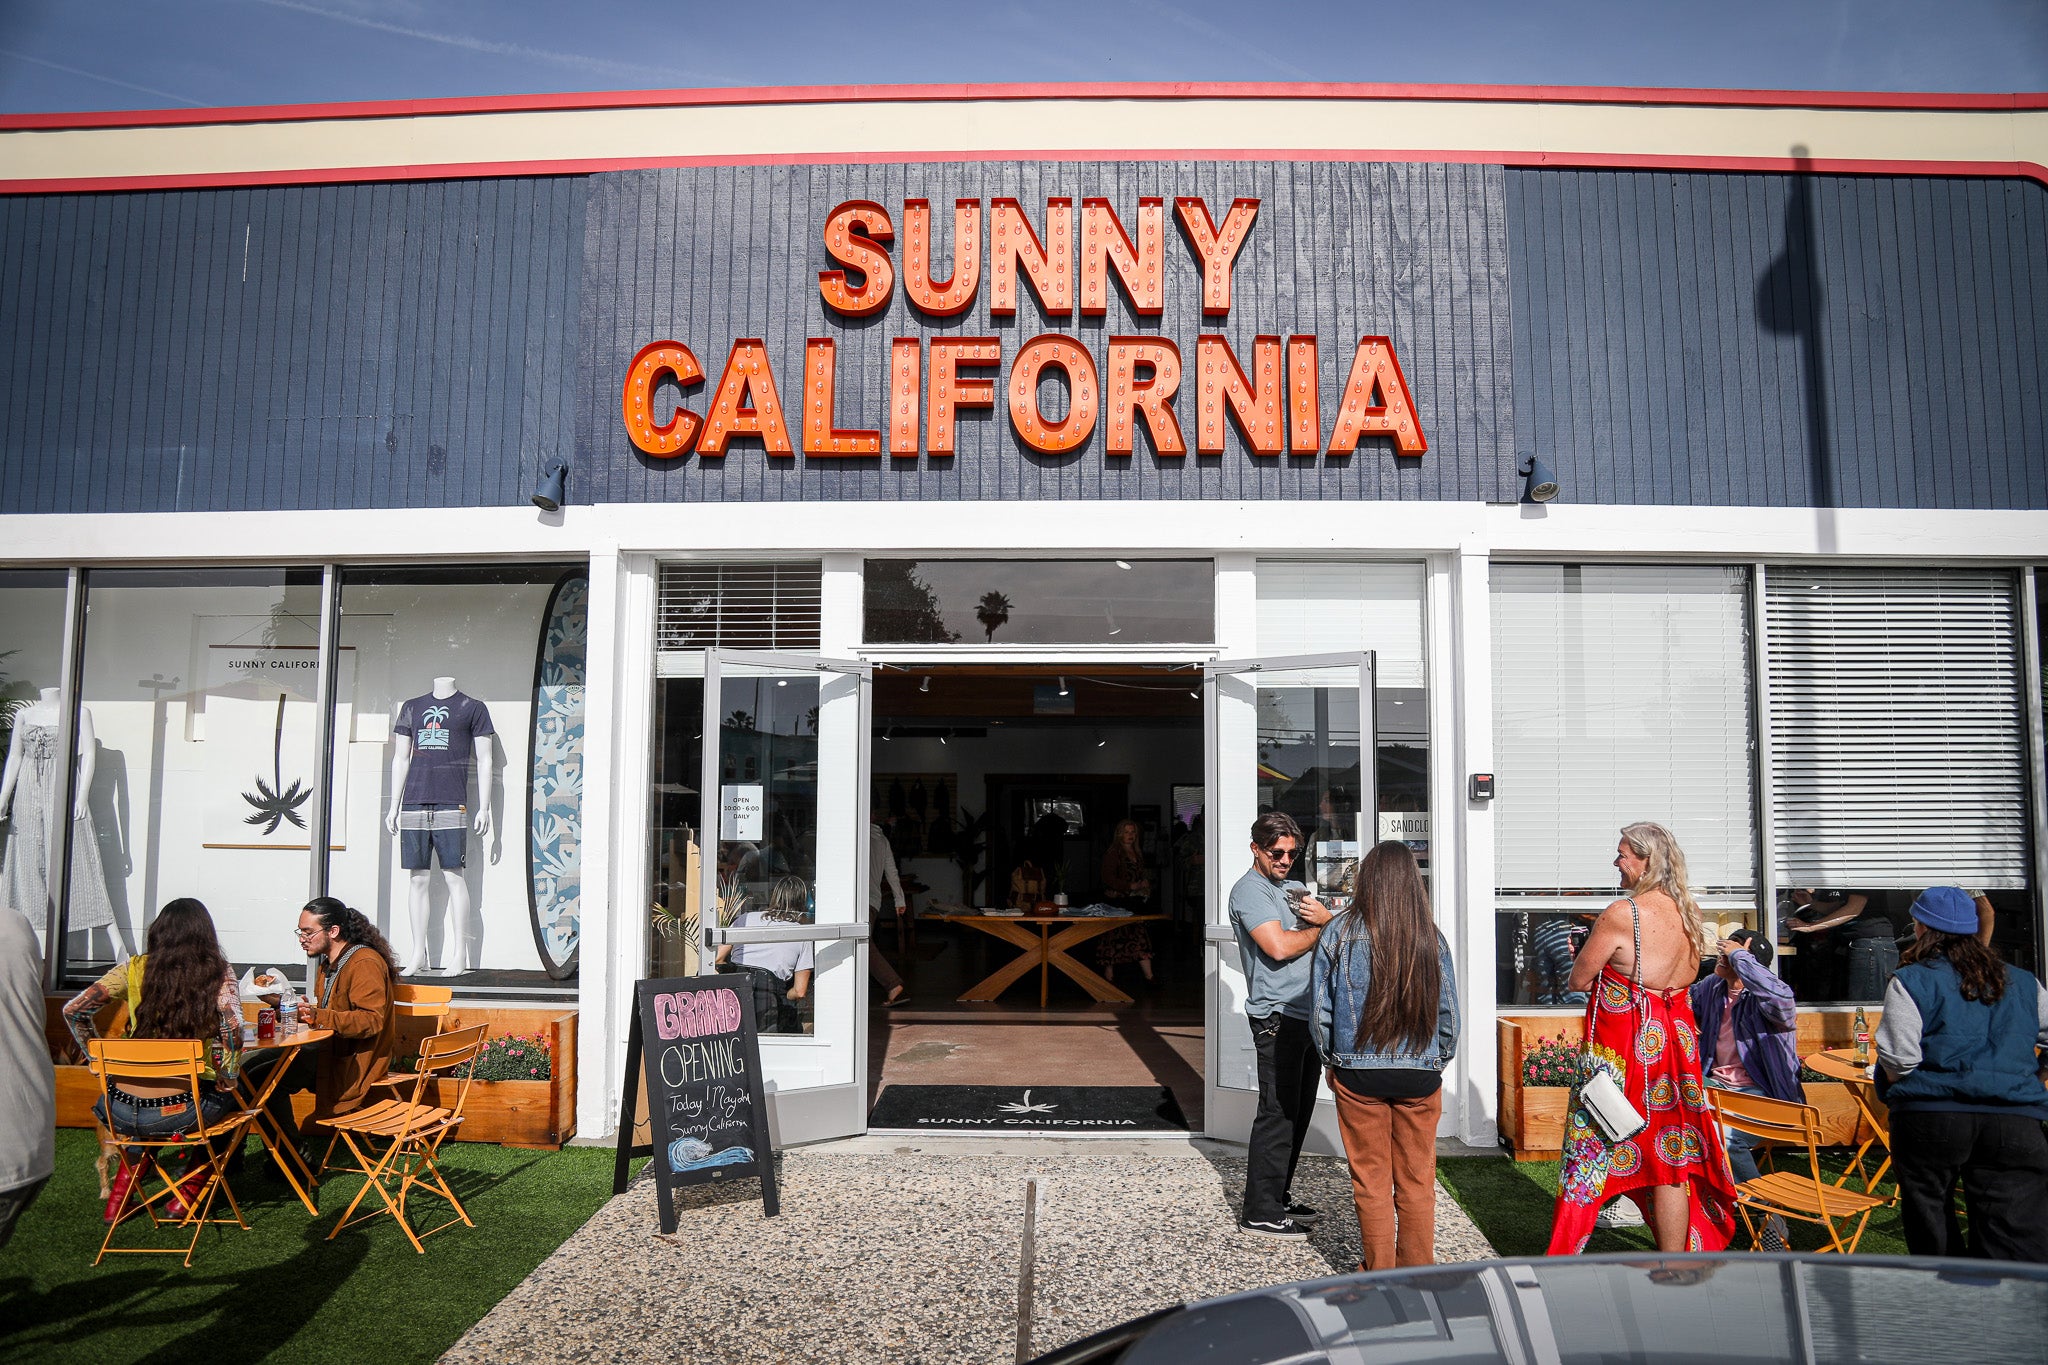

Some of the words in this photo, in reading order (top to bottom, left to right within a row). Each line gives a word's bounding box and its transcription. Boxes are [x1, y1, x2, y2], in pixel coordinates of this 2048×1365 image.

[818, 197, 1261, 318] SUNNY
[623, 334, 1428, 459] CALIFORNIA
[228, 660, 266, 669] SUNNY
[270, 660, 319, 669] CALIFOR
[654, 988, 742, 1040] GRAND
[660, 1037, 745, 1088] OPENING
[711, 1085, 737, 1118] May
[671, 1123, 708, 1143] Sunny
[708, 1115, 748, 1132] California
